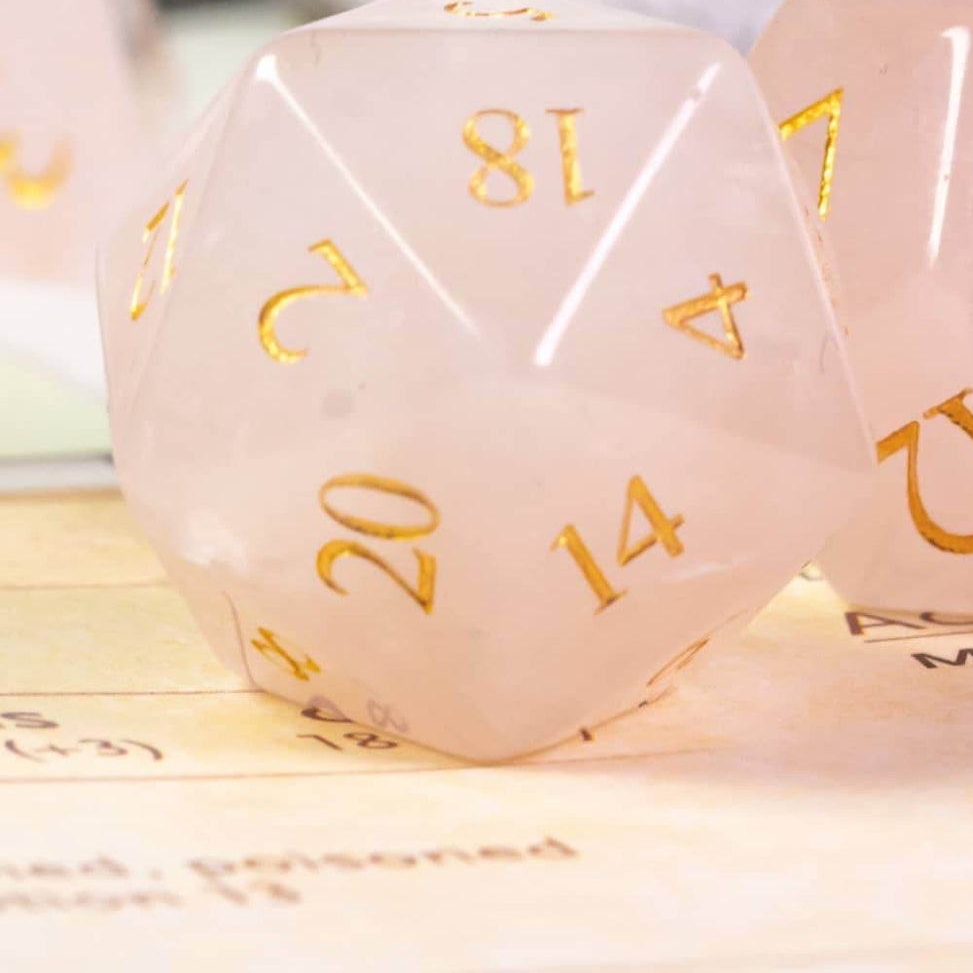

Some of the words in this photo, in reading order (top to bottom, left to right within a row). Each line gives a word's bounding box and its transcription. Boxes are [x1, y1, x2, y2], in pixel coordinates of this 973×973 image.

[461, 107, 595, 208] 18
[258, 238, 369, 365] 2
[661, 272, 749, 361] 4
[315, 472, 442, 615] 20
[550, 474, 686, 616] 14
[5, 738, 164, 763] (+3)
[295, 731, 399, 752] 18
